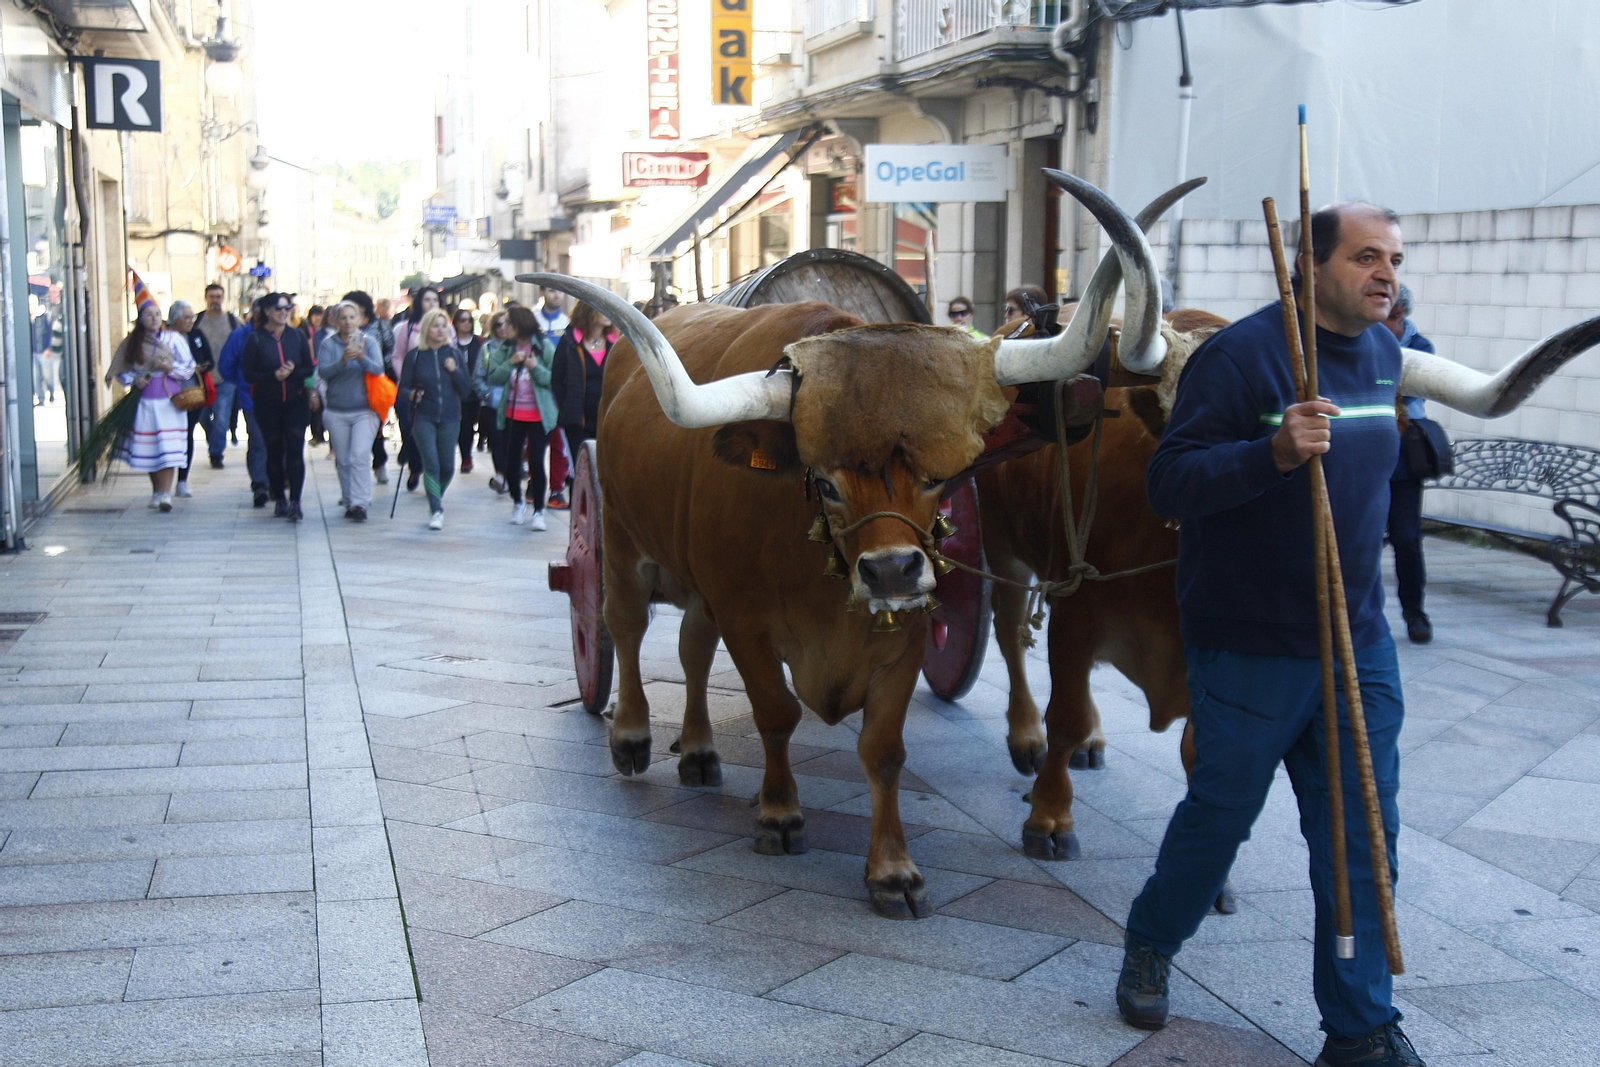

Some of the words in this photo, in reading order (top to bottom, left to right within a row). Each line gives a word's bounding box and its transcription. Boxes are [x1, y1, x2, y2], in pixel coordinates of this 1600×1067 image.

[718, 0, 748, 104] ak
[94, 64, 152, 126] R
[877, 161, 965, 186] OpeGal
